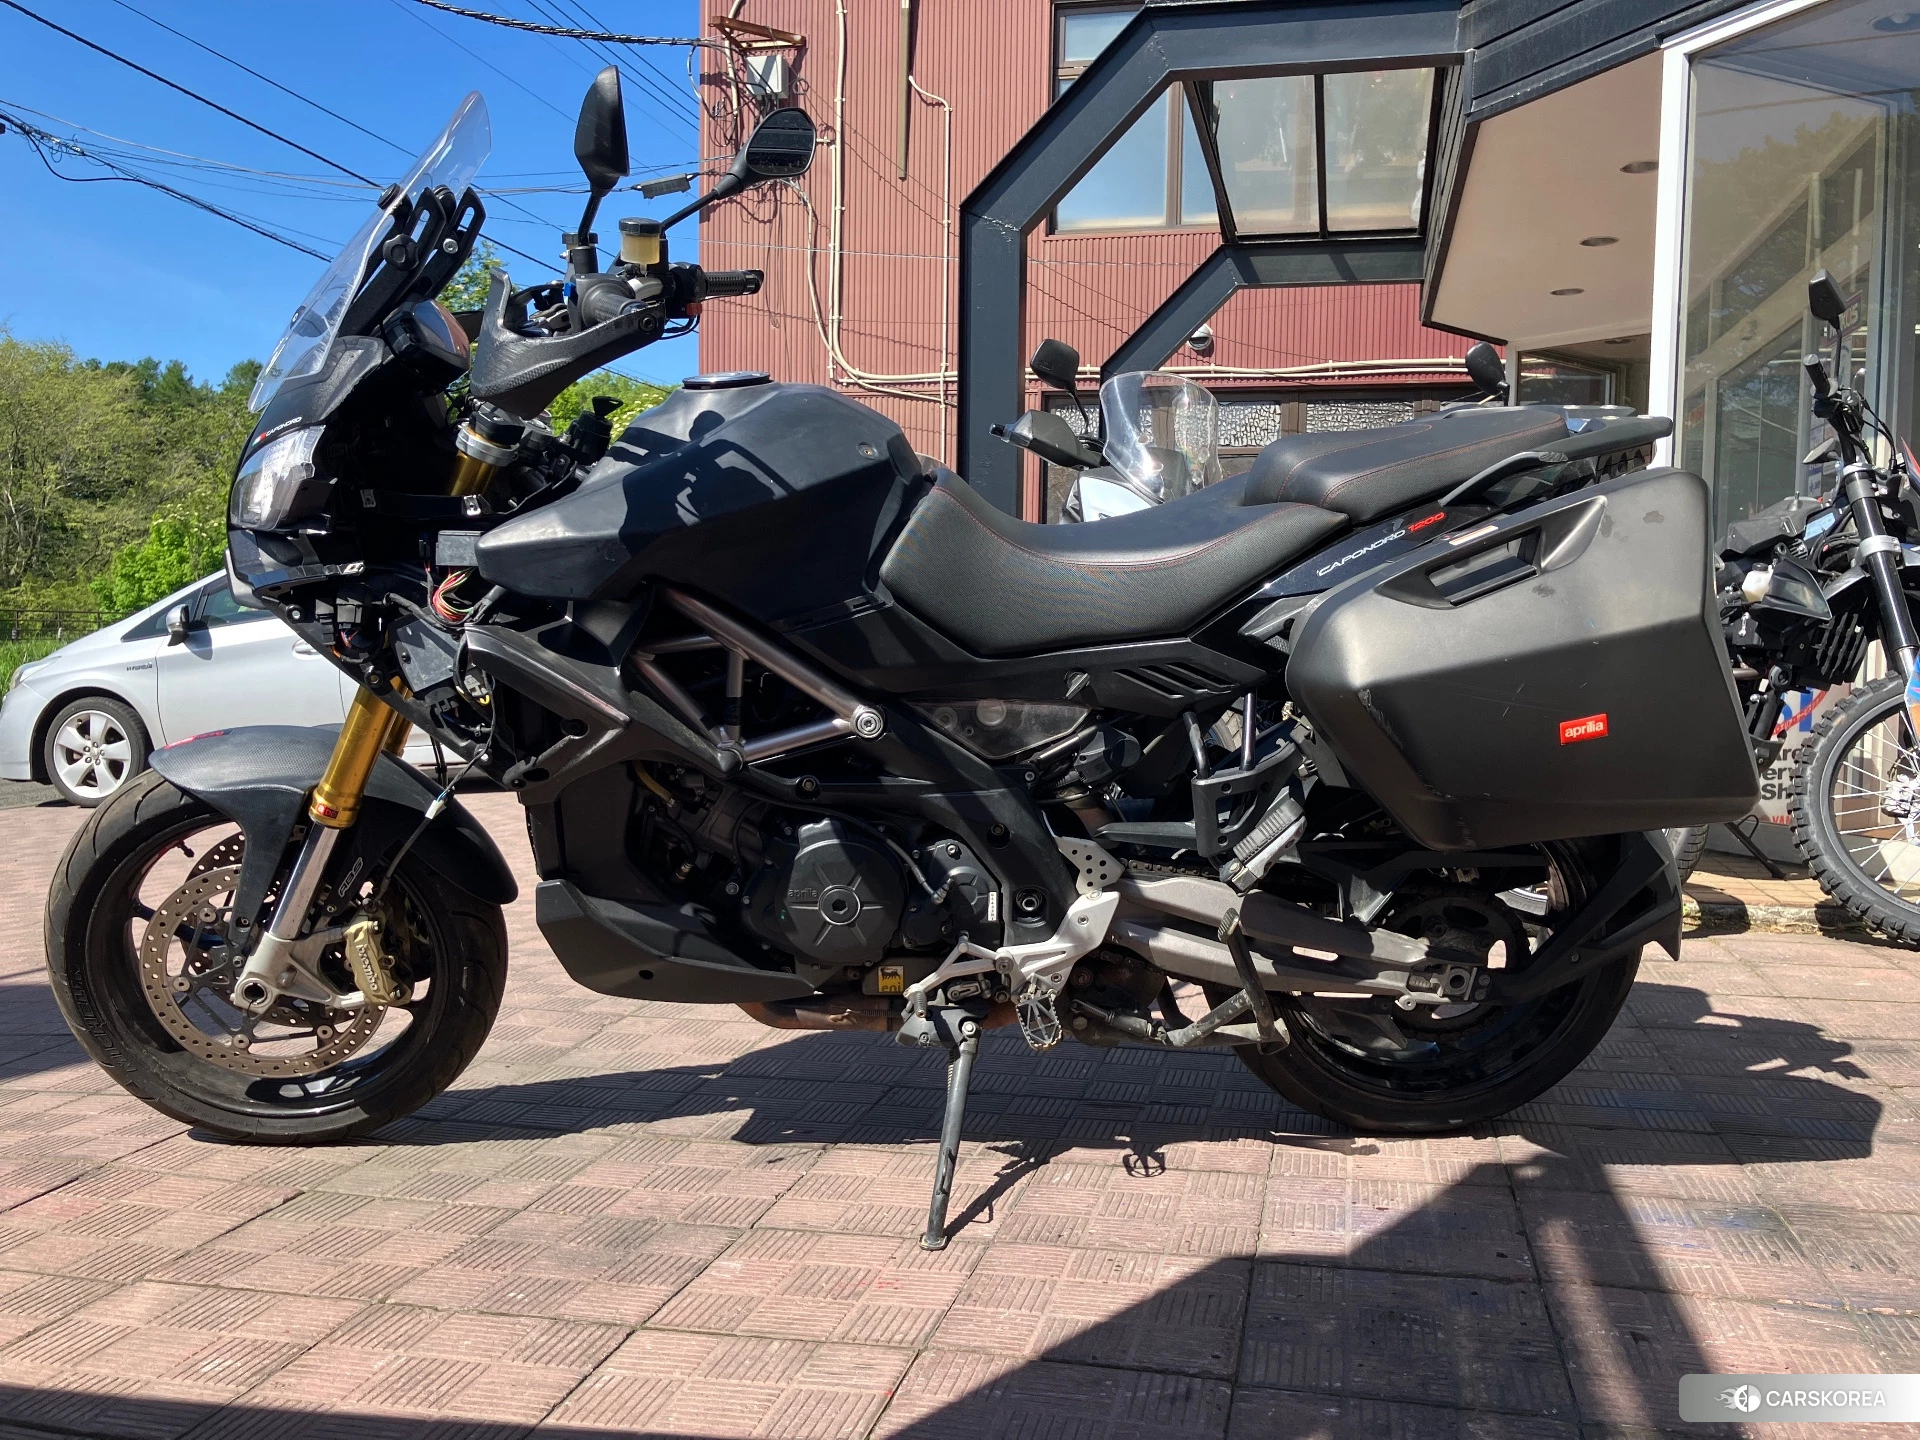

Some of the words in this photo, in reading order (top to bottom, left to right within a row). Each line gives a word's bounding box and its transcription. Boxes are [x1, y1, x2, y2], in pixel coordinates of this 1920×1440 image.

[1317, 529, 1406, 577] CAPONORD
[1407, 511, 1446, 532] 1200
[1565, 720, 1604, 738] aprilia
[1761, 783, 1788, 800] Sh
[338, 856, 364, 898] ABS
[788, 887, 820, 900] aprilia
[355, 943, 378, 991] brembo
[881, 981, 901, 992] eni
